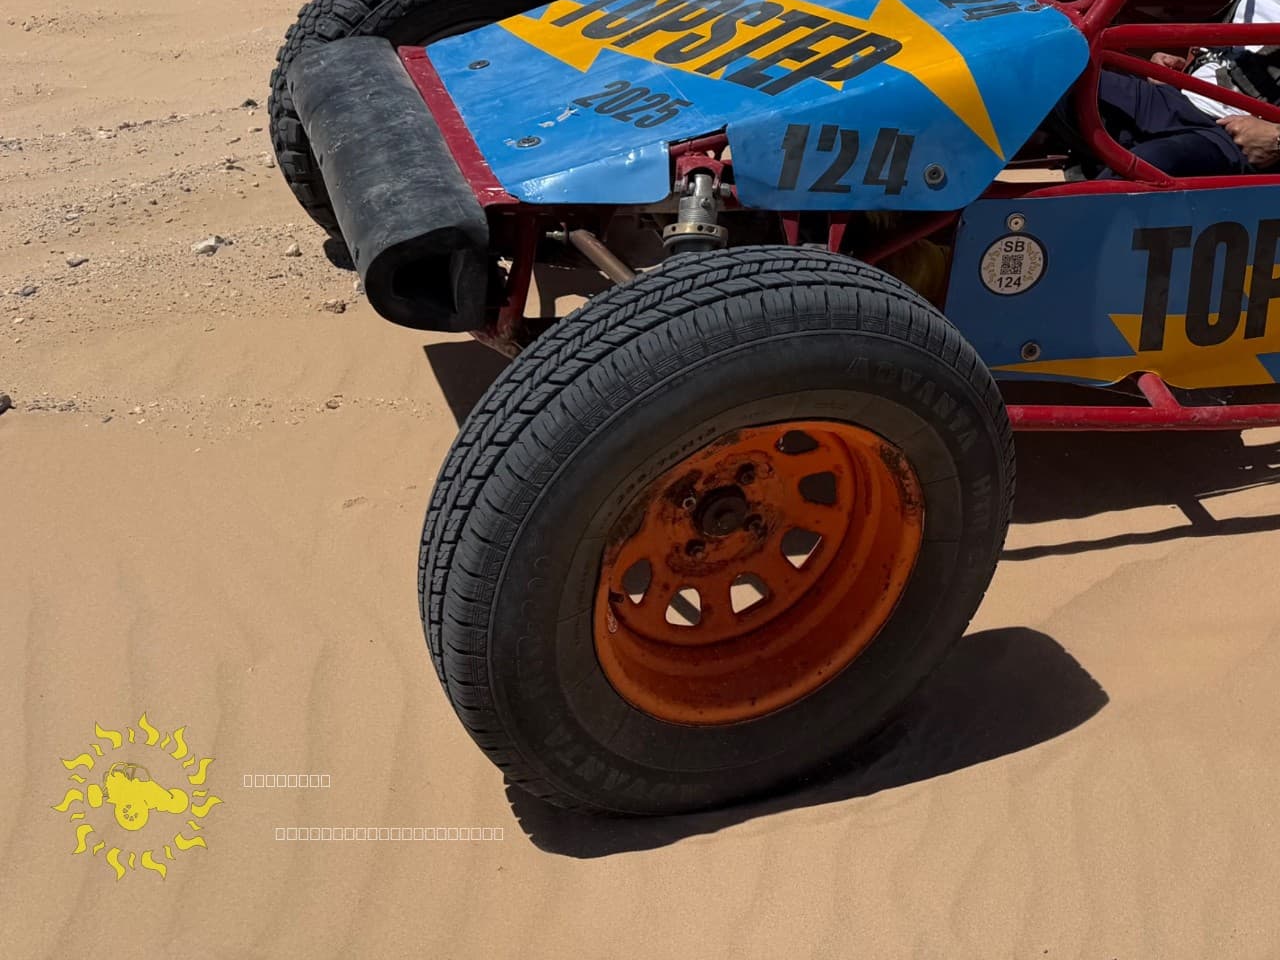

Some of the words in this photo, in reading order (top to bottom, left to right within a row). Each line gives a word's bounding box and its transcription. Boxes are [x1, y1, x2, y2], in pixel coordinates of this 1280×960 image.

[573, 80, 693, 129] 2025
[777, 124, 915, 195] 124
[1003, 241, 1025, 253] SB
[997, 276, 1022, 289] 124
